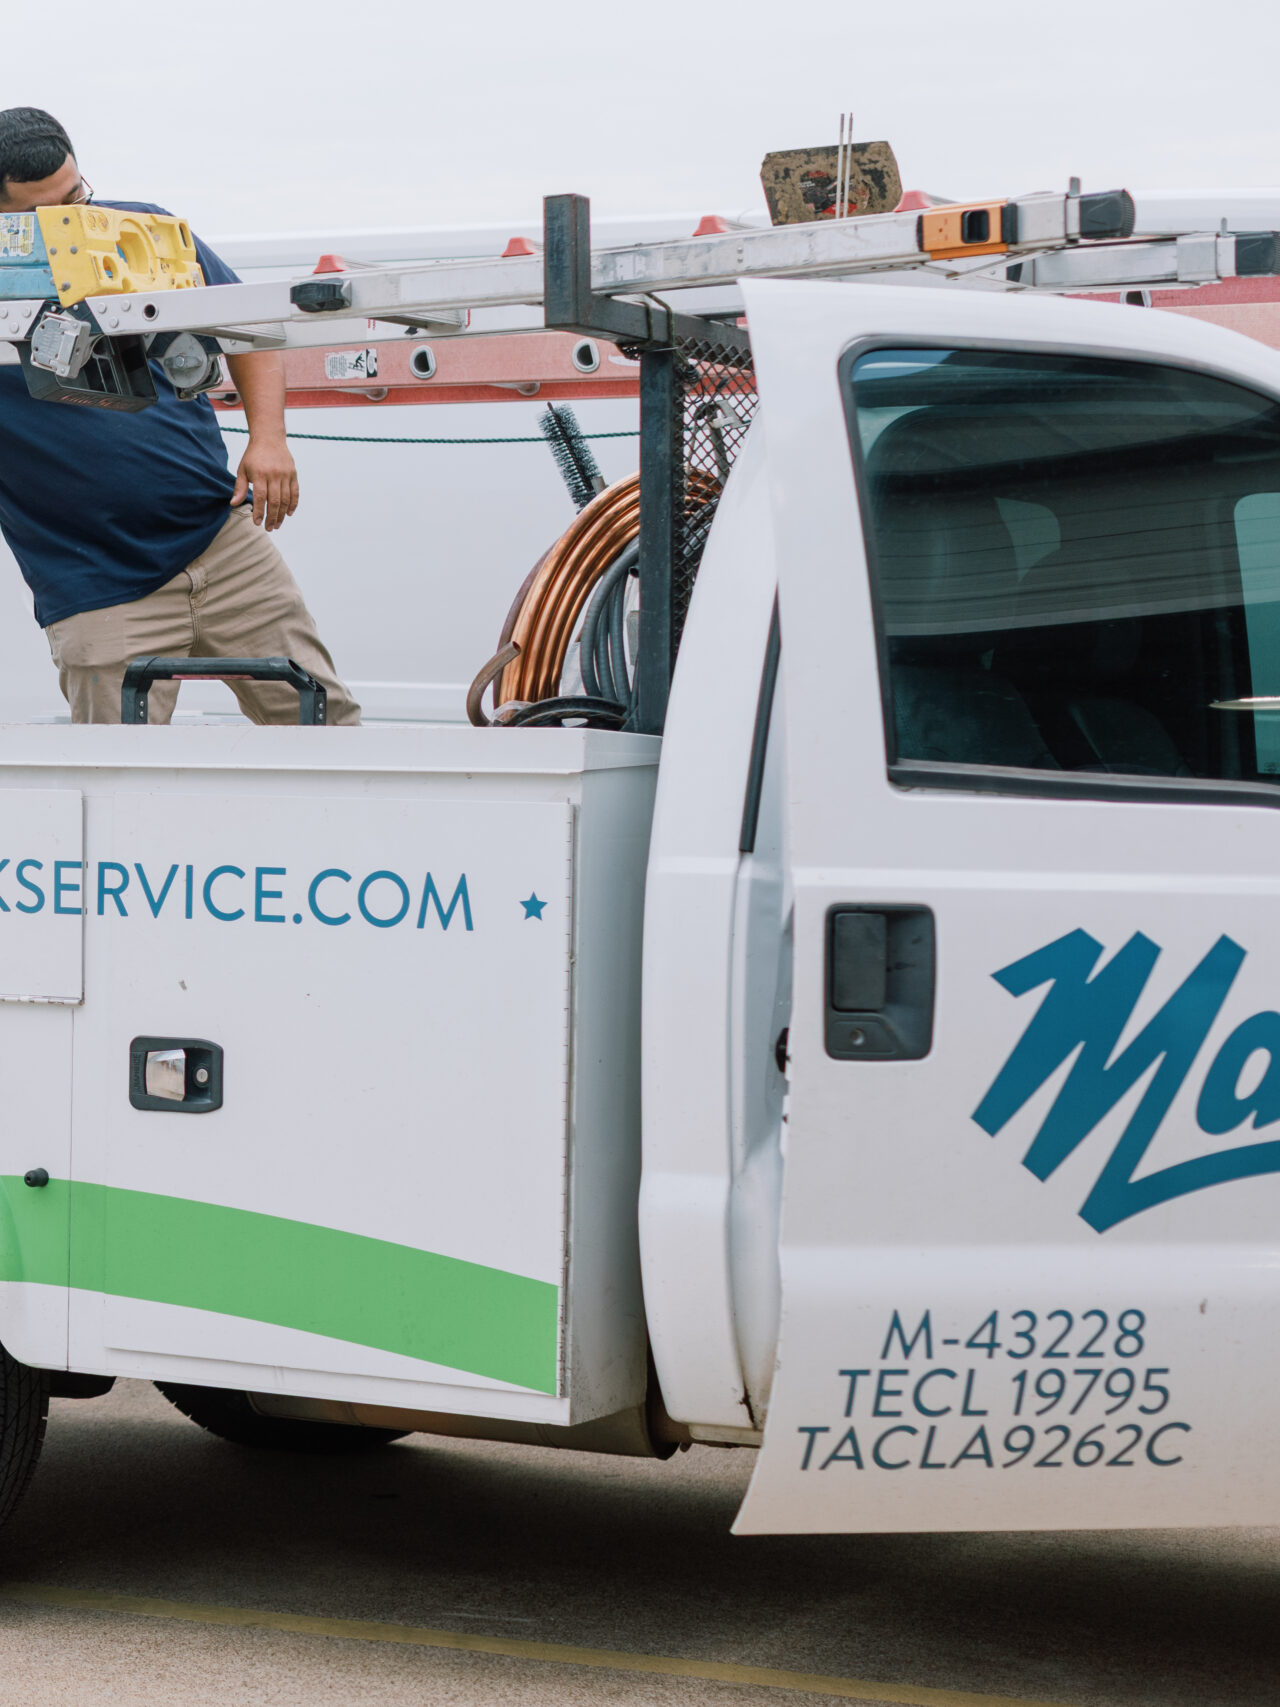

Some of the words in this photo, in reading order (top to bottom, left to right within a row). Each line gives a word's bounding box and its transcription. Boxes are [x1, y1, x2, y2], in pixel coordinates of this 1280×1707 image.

[881, 1308, 1146, 1360] M-43228
[838, 1368, 988, 1417] TECL
[1011, 1367, 1170, 1415] 19795
[797, 1422, 1191, 1471] TACLA9262C
